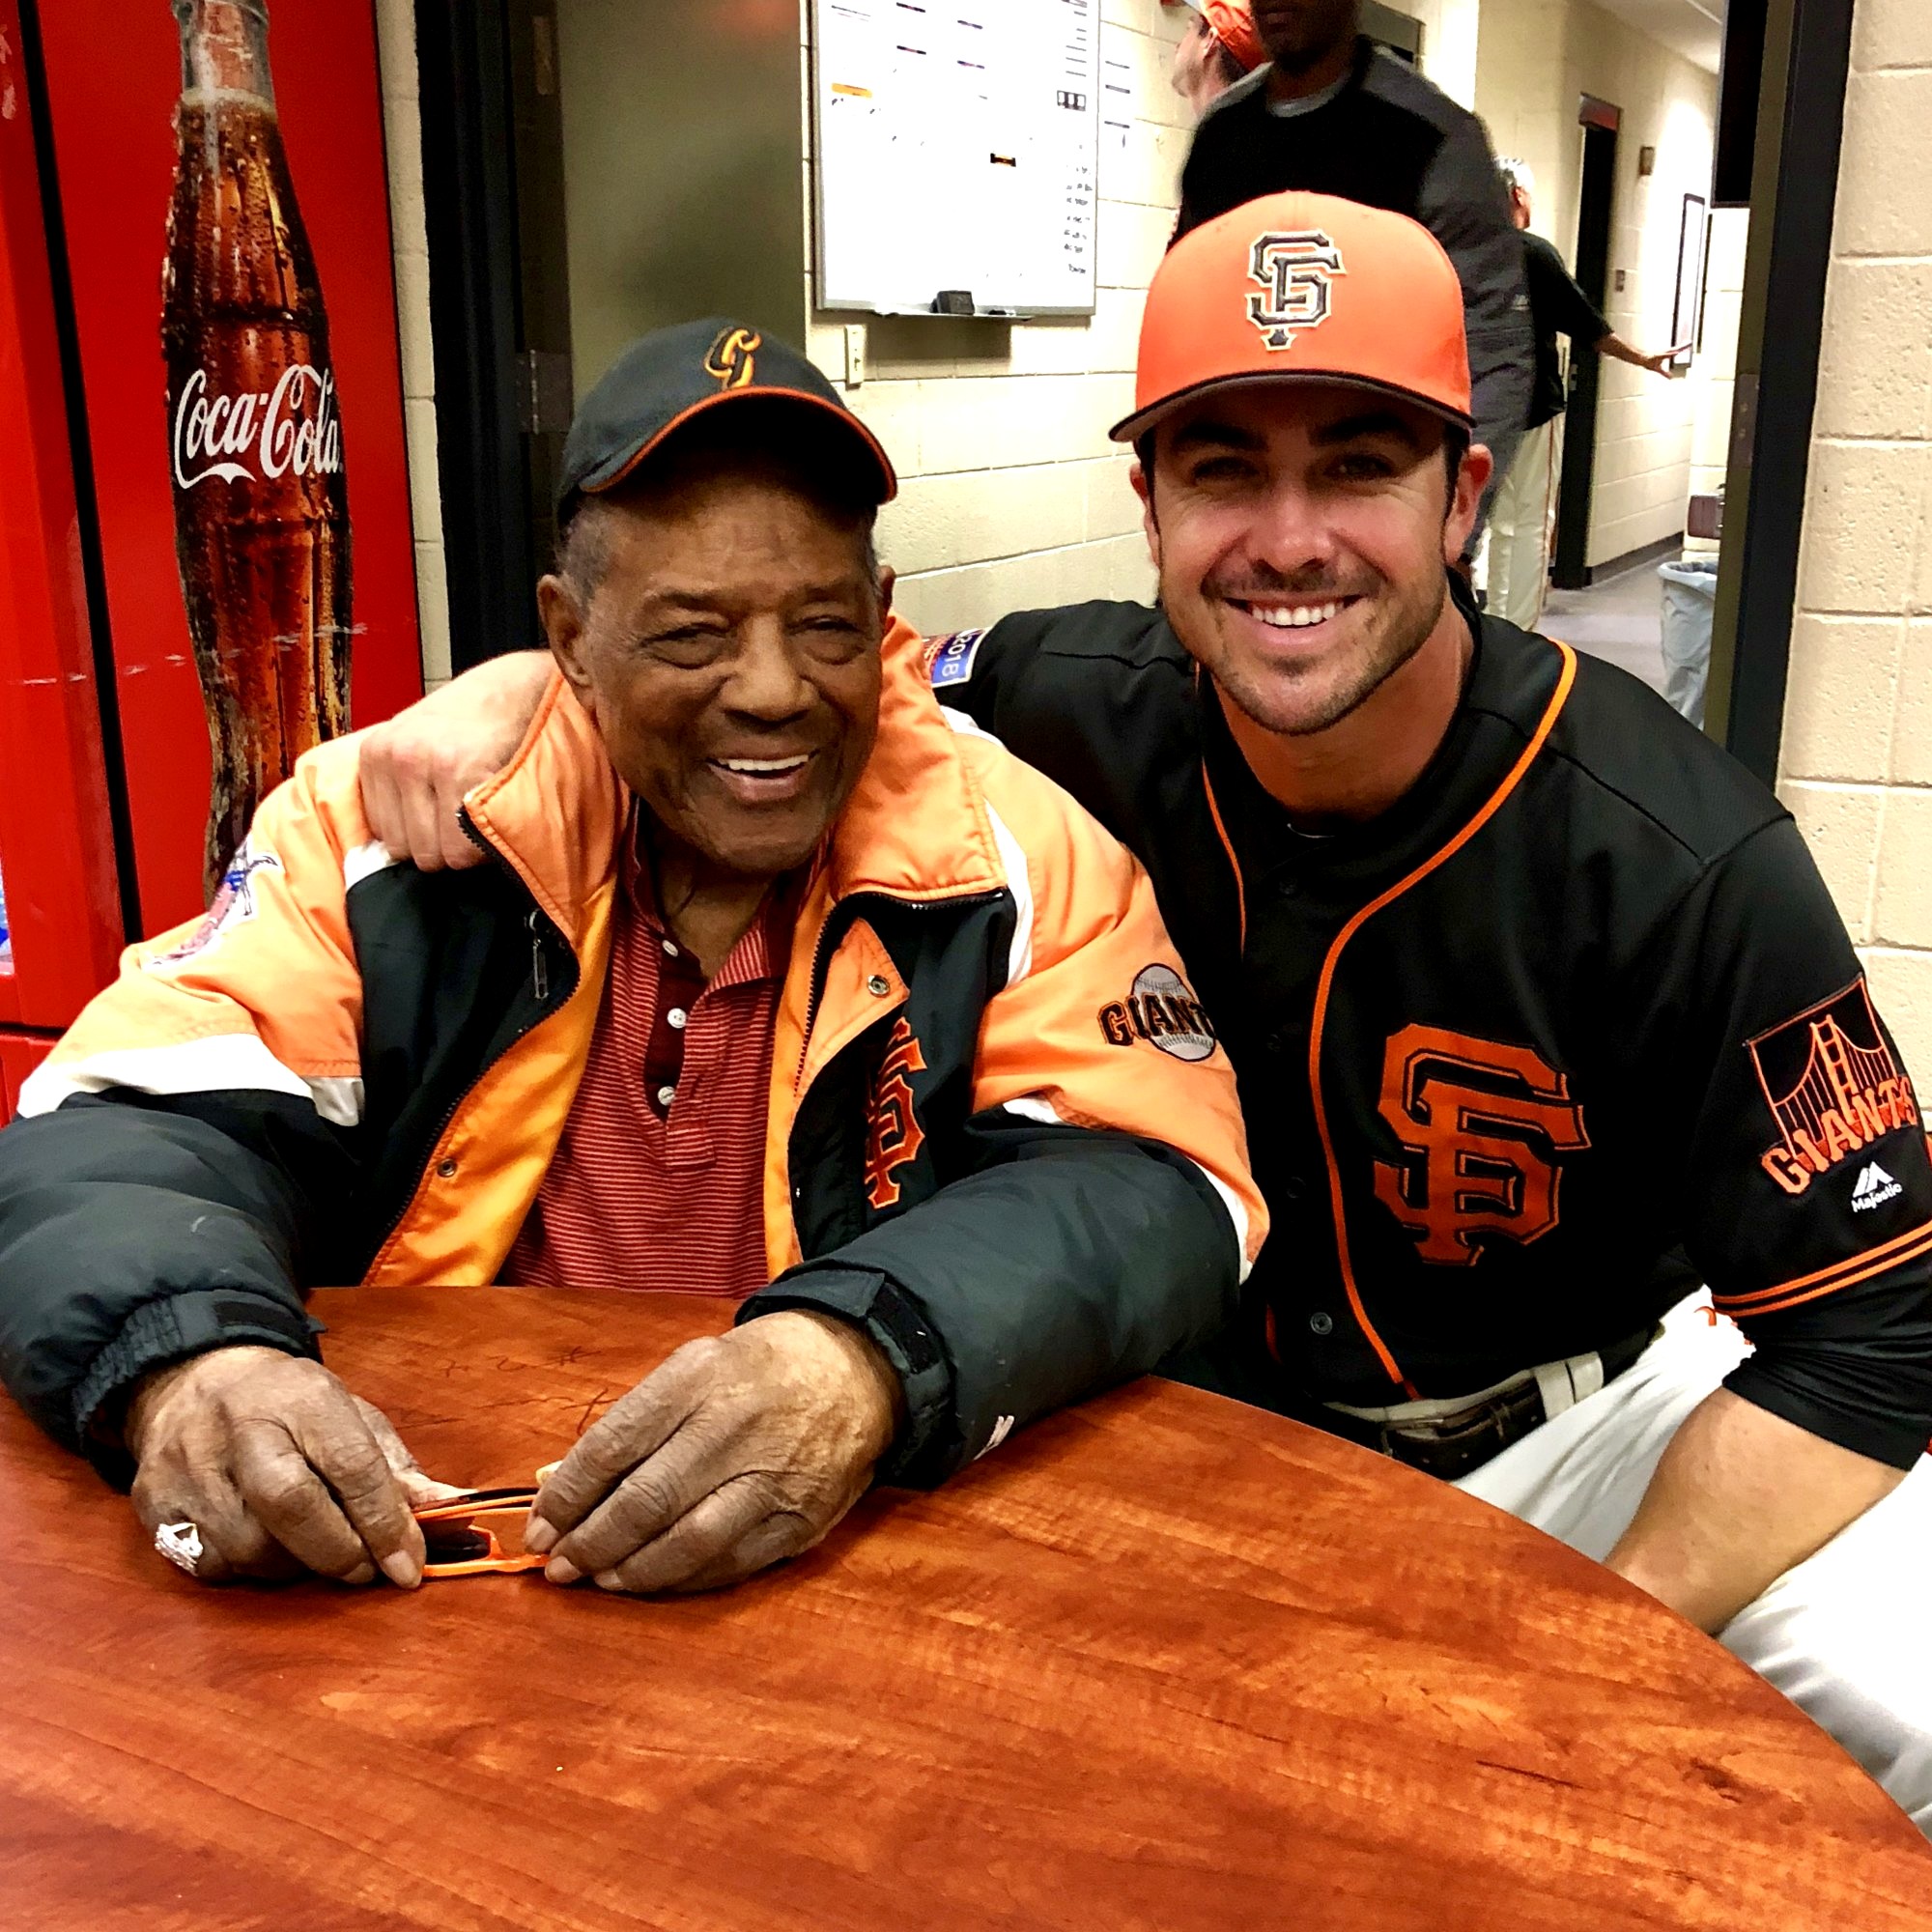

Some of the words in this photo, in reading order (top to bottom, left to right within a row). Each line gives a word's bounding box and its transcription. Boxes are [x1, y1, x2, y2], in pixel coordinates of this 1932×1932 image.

[1244, 229, 1348, 351] SF
[175, 364, 339, 490] Coca-Cola
[941, 633, 973, 677] 2018
[1096, 992, 1216, 1046] GIANT
[1373, 1022, 1592, 1266] SF
[1761, 1074, 1918, 1194] GIANTS
[1851, 1183, 1903, 1213] Majestic
